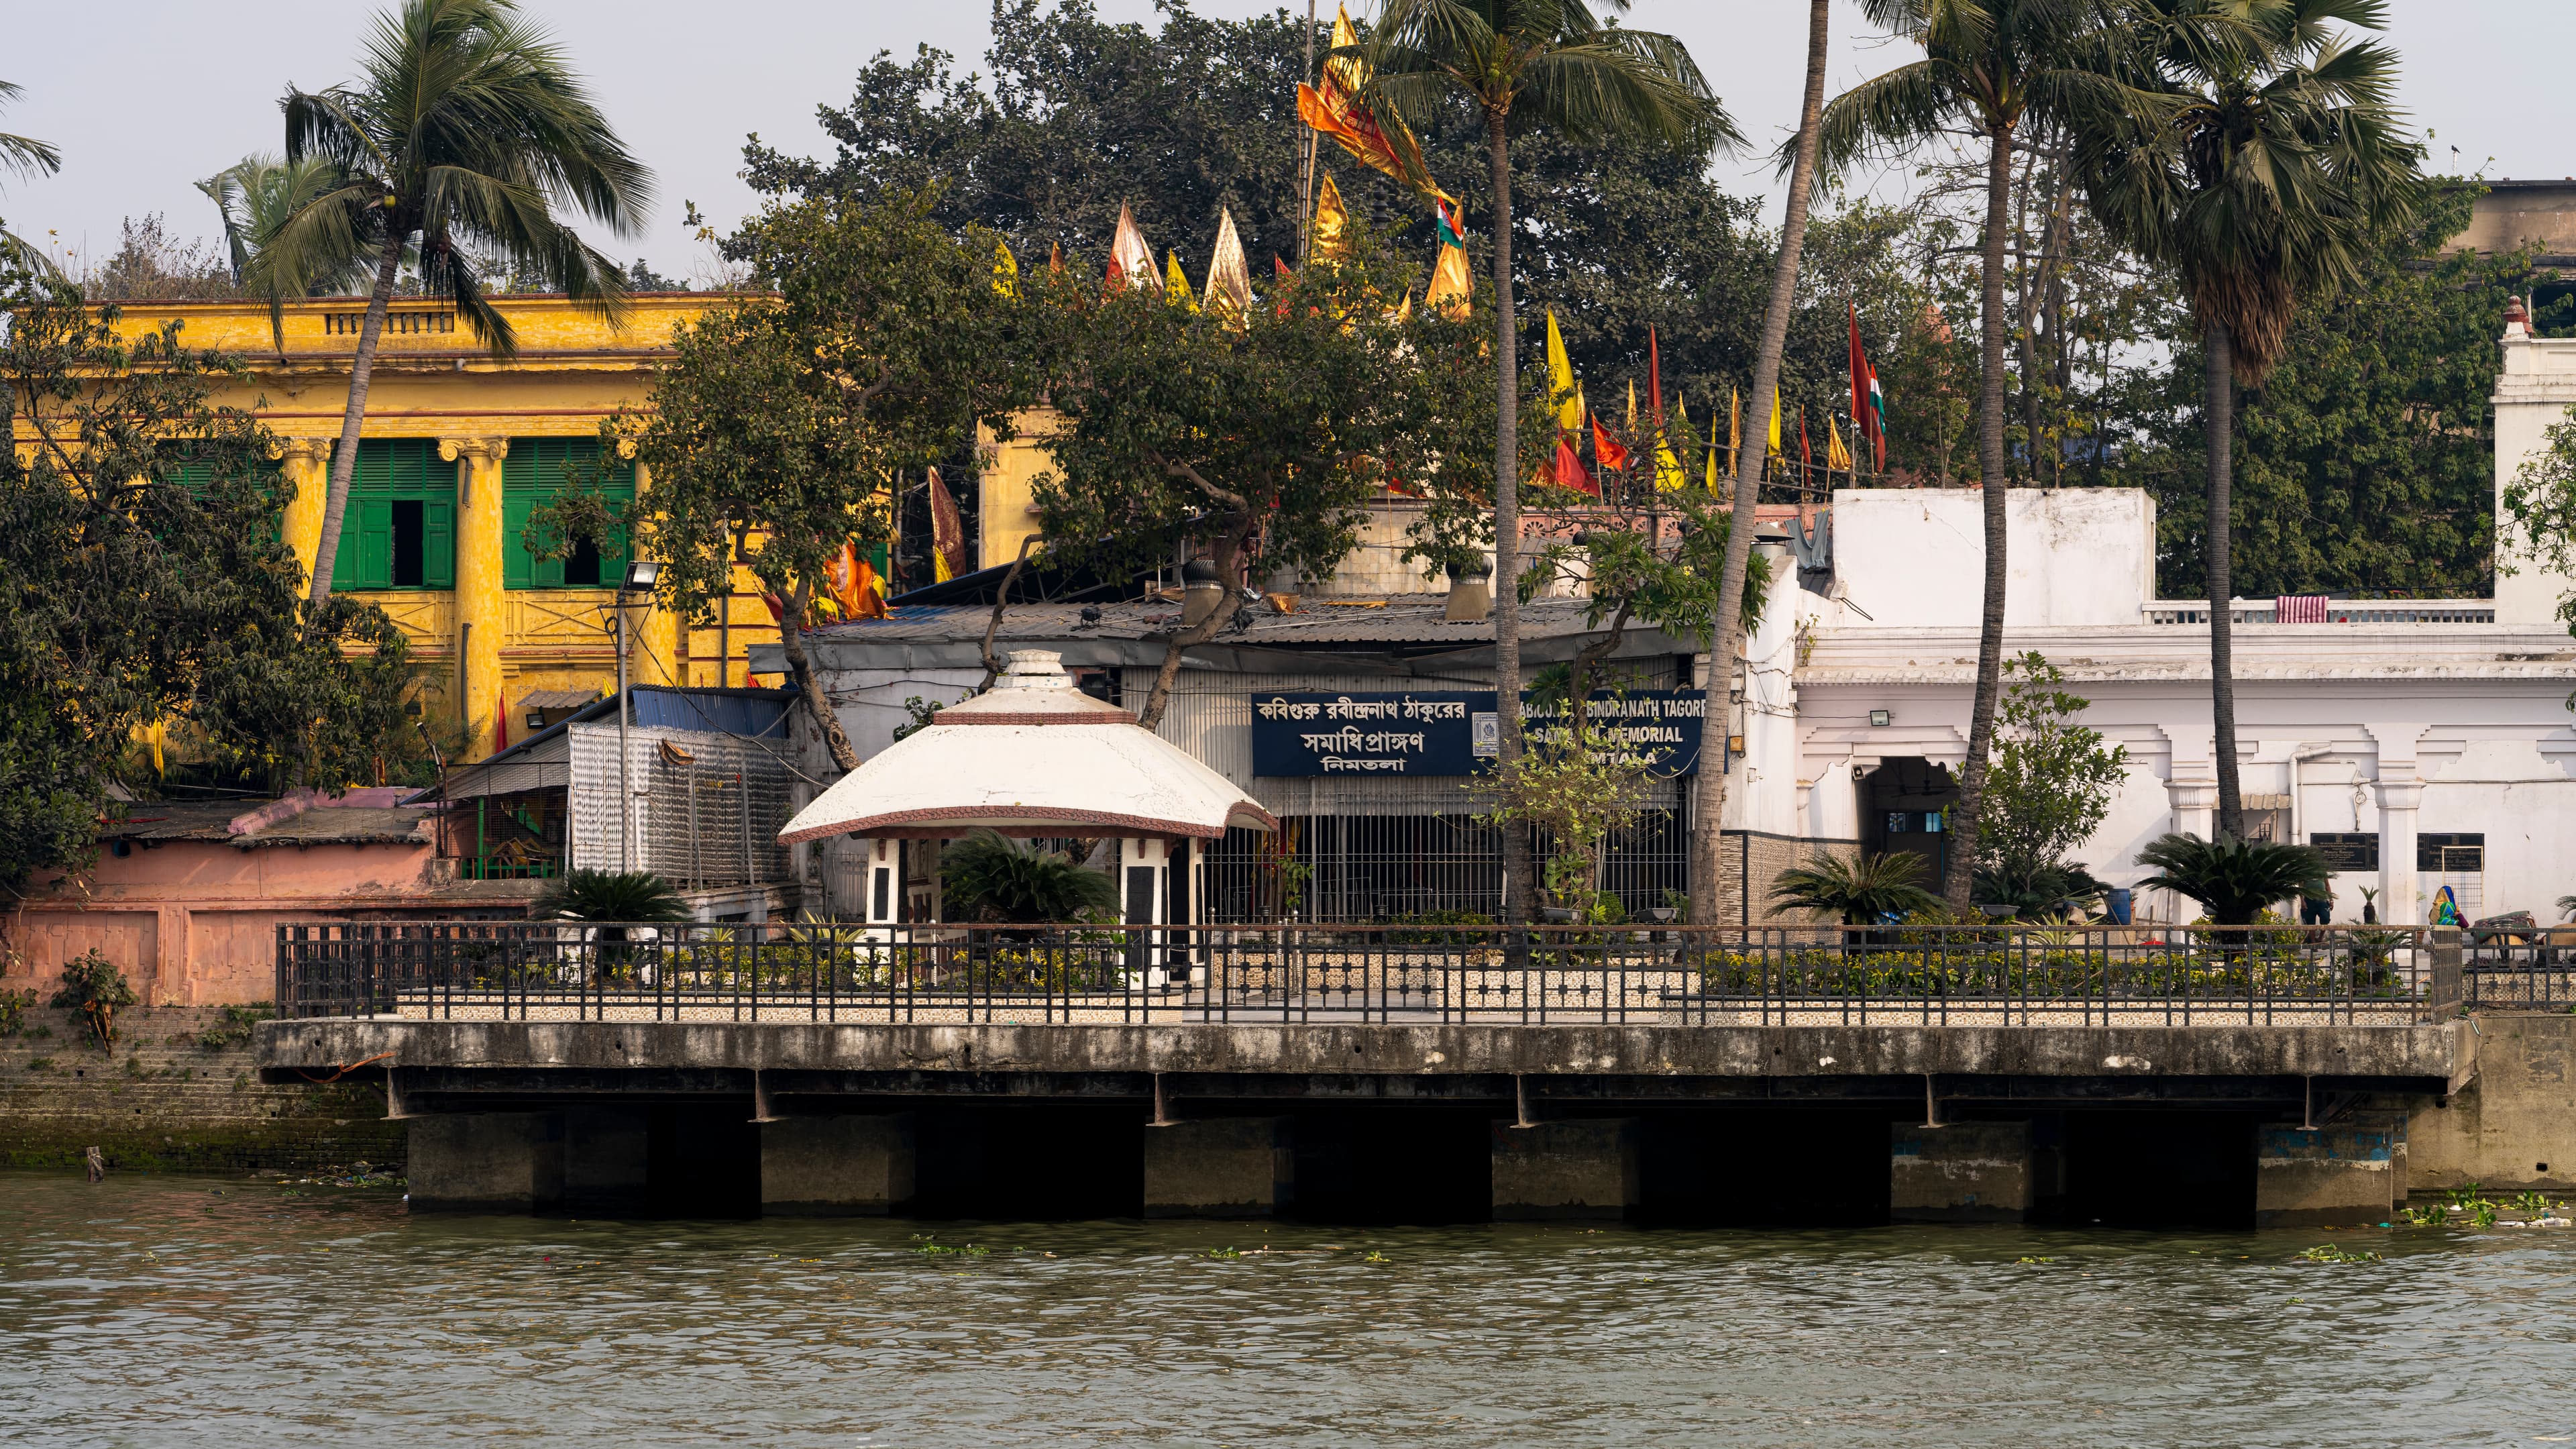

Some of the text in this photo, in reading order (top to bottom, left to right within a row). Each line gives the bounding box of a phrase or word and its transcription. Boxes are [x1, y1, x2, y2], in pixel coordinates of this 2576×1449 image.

[1256, 696, 1466, 724] কবিগুরু রবীন্দ্রনাথ ঠাকুরের
[1608, 727, 1683, 743] MEMORIAL
[1320, 755, 1407, 771] নিমতলা
